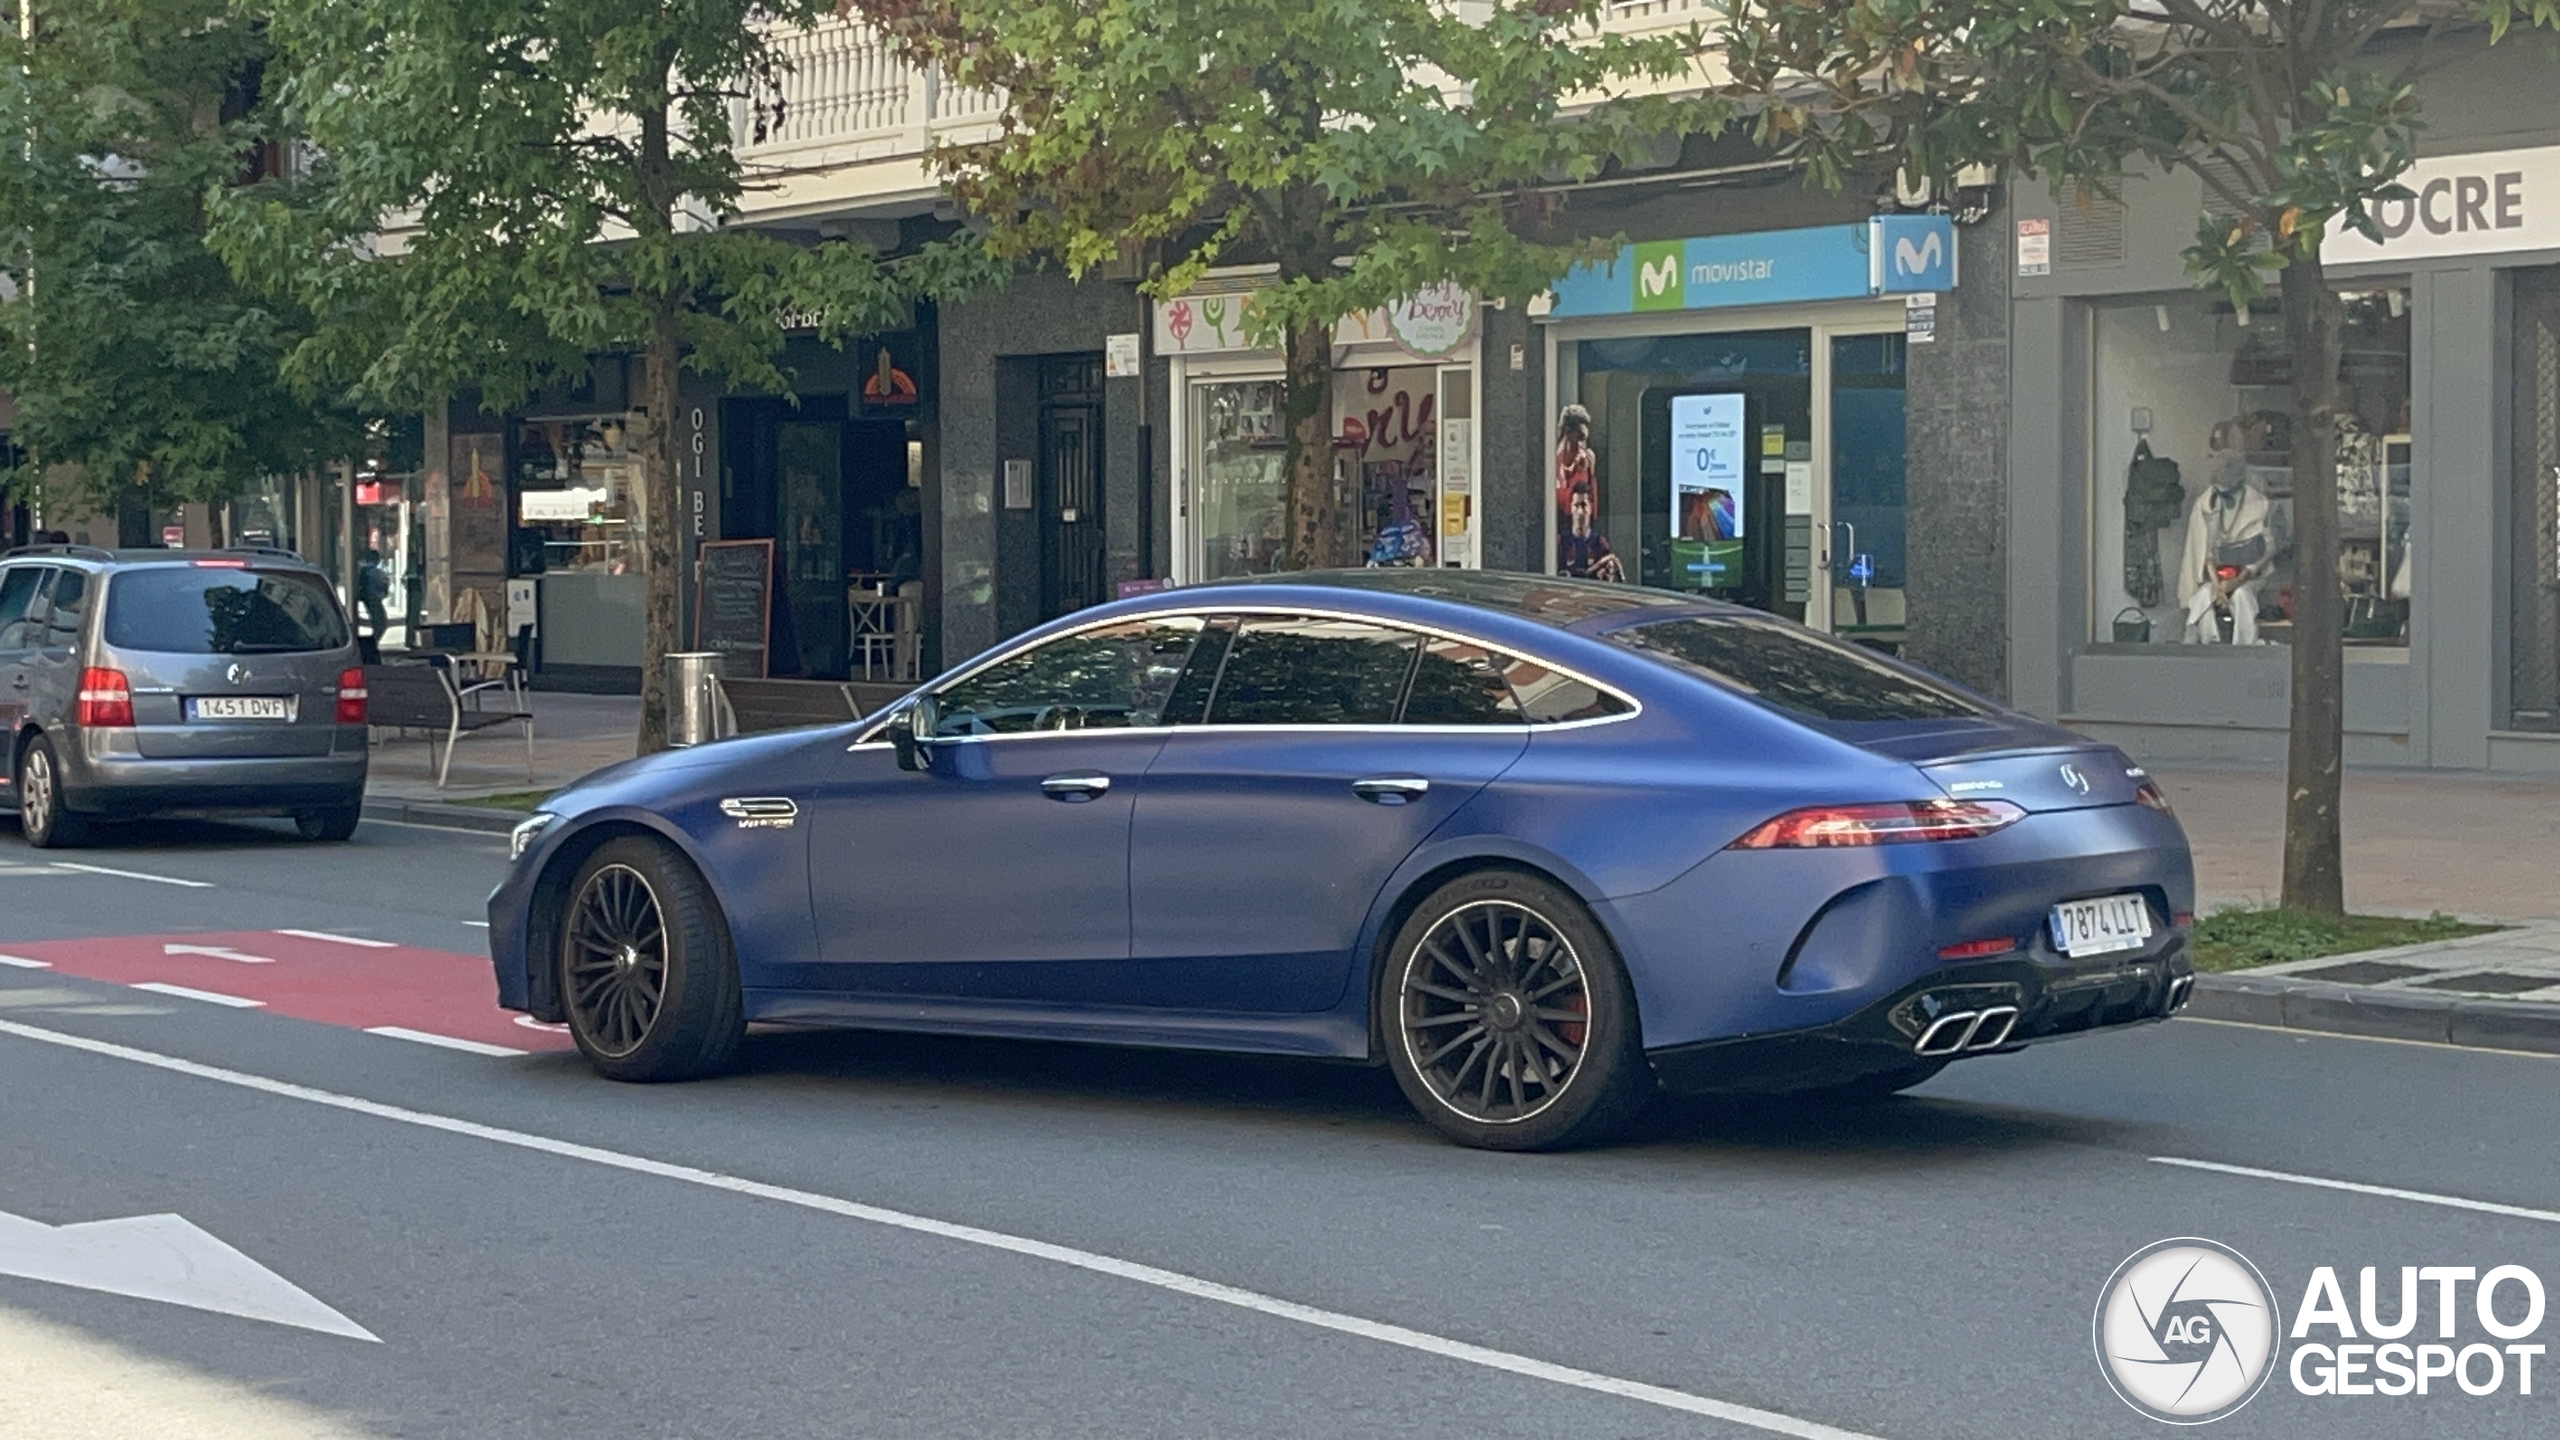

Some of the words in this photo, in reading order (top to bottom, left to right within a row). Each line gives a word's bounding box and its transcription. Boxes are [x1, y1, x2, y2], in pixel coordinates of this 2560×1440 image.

[2371, 171, 2523, 239] OCRE
[1691, 258, 1775, 284] movistar
[691, 408, 705, 478] OGI
[203, 699, 246, 716] 1451
[251, 699, 281, 716] DVF
[2063, 904, 2111, 941] 7874
[2110, 899, 2143, 935] LLT
